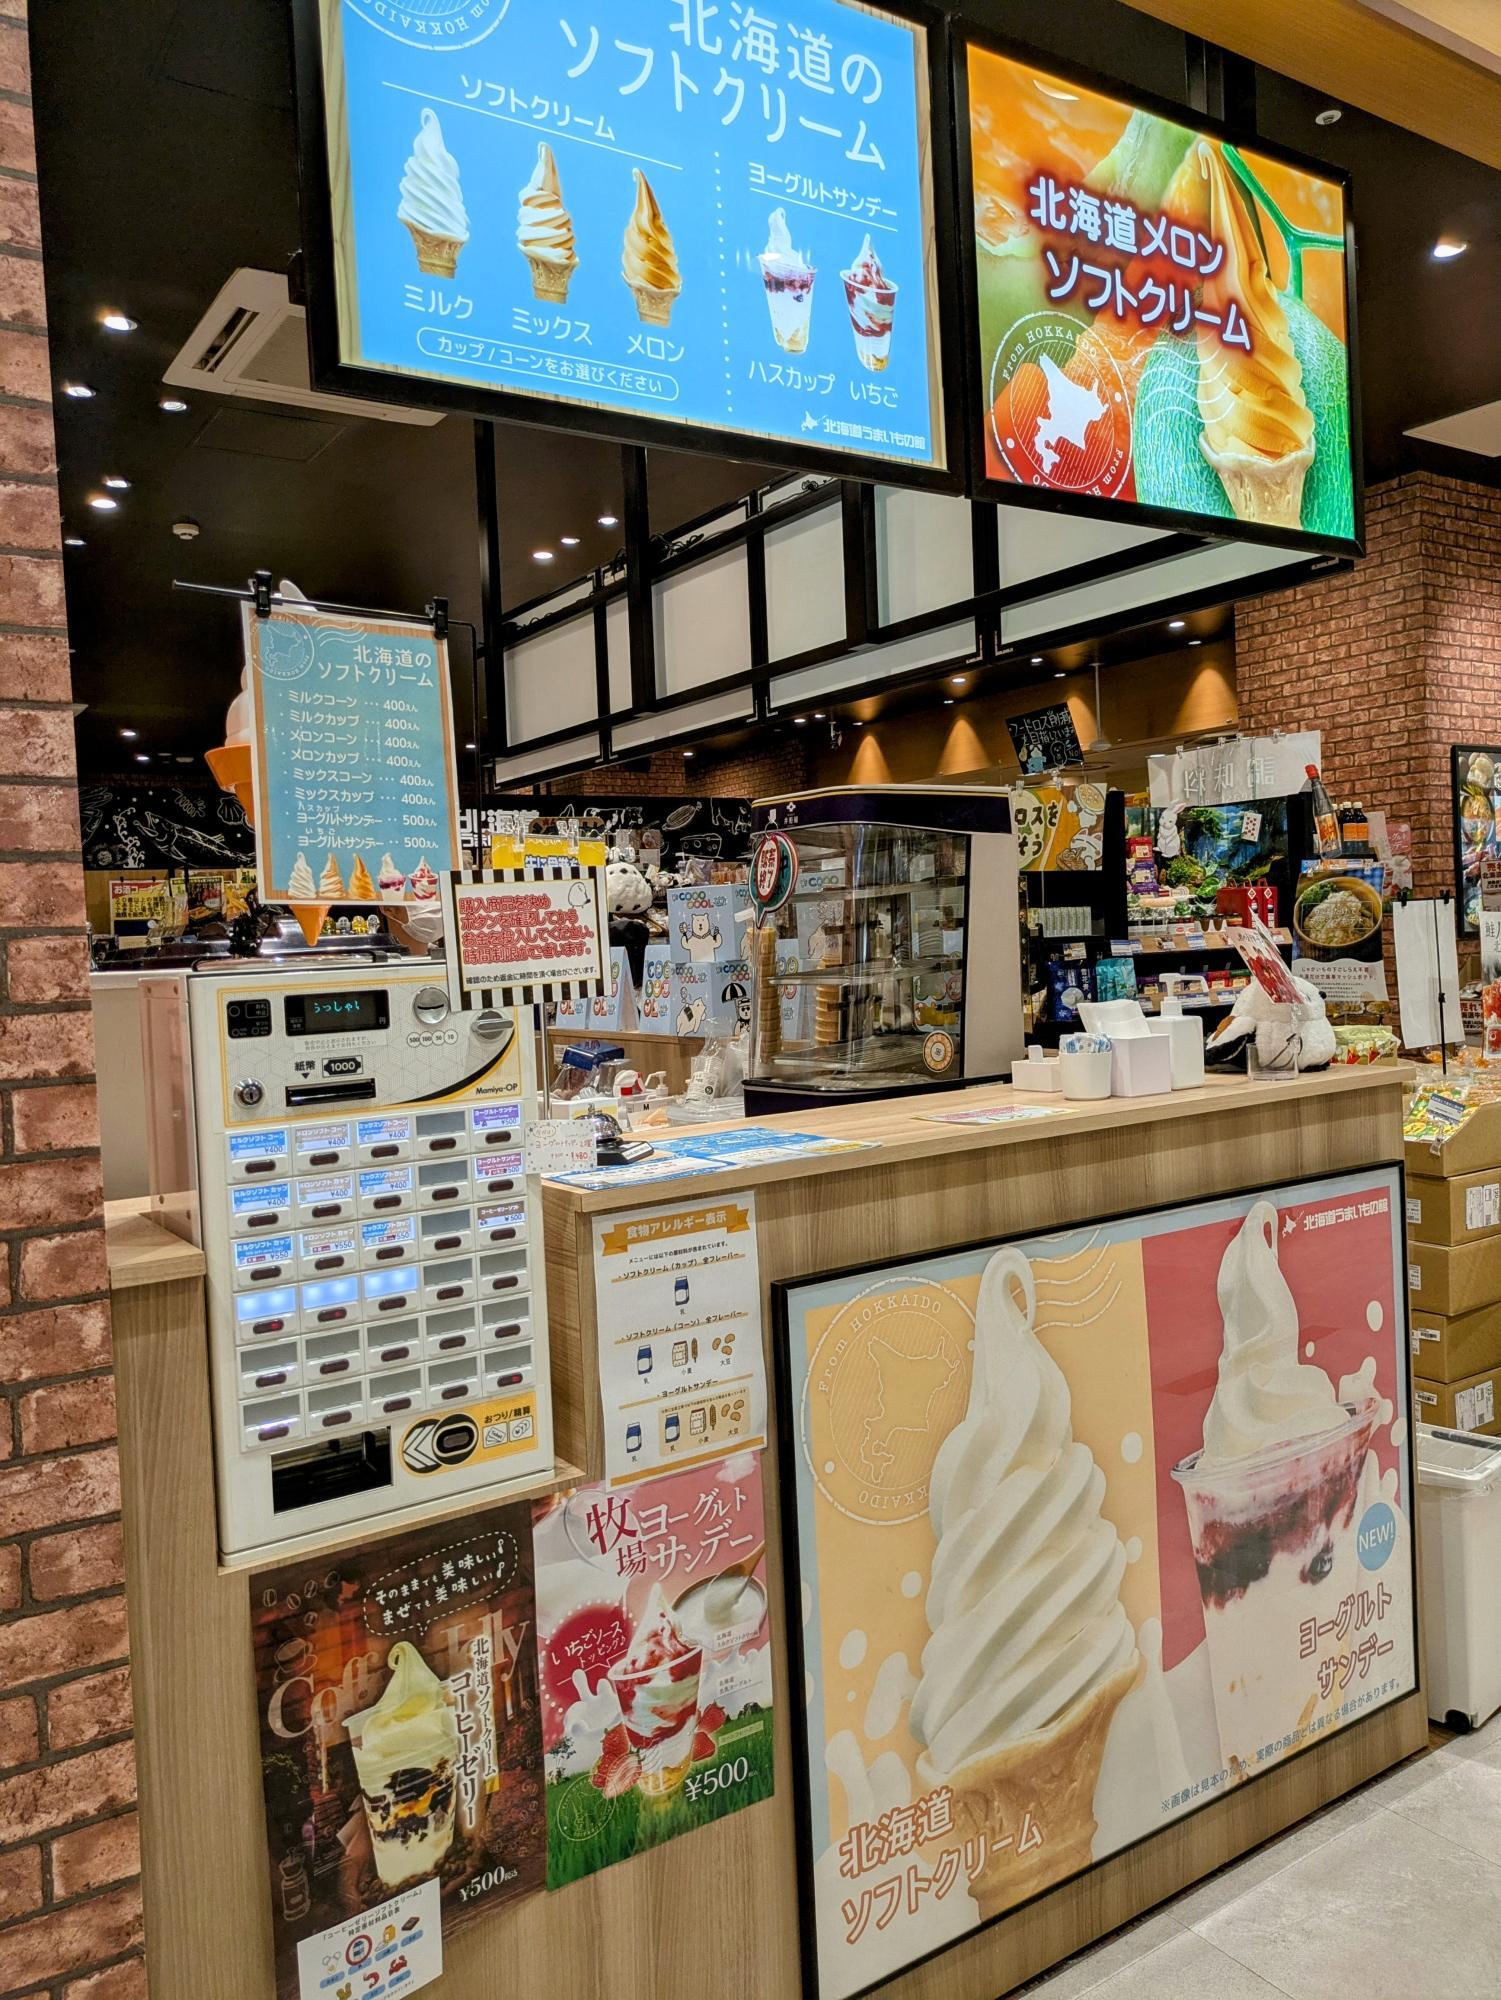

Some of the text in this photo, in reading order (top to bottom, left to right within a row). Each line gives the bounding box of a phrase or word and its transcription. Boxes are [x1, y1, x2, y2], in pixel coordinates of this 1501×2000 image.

[670, 0, 883, 104] 北海道の
[461, 73, 616, 142] ソフトクリーム
[559, 18, 887, 171] ソフトクリーム
[748, 162, 899, 219] ヨーグルトサンデー
[1029, 175, 1224, 275] 北海道メロン
[403, 284, 474, 321] ミルク
[1045, 250, 1252, 351] ソフトクリーム
[511, 306, 594, 346] ミックス
[627, 334, 686, 364] メロン
[747, 361, 836, 398] ハスカップ
[849, 380, 900, 409] いちご
[823, 418, 926, 450] 北海道うまいもの館
[353, 644, 433, 669] 北海道の
[318, 661, 434, 688] ソフトクリーム
[288, 689, 419, 713] ミルクコーン 400えん
[289, 708, 420, 731] ミルクカップ 400えん
[289, 729, 420, 750] メロンコーン 400えん
[290, 748, 422, 768] メロンカップ 400えん
[293, 767, 435, 788] ミックスコーン 400えん
[294, 786, 437, 806] ミックスカップ 400えん
[296, 811, 437, 828] ヨーグルトサンデー 500えん
[1014, 801, 1059, 827] ロスを
[298, 835, 439, 850] ヨーグルトサンデー 500えん
[458, 893, 551, 915] 購入商品を決め
[460, 909, 579, 931] ボタンを確認してから
[463, 941, 592, 966] 時間制限がございます。
[294, 1060, 356, 1071] 紙幣 1000
[475, 1083, 518, 1095] Mamiya-OP
[625, 1210, 728, 1240] 食物アレルギー表示
[1303, 1197, 1389, 1231] 北海道うまいもの館
[702, 1252, 740, 1265] 全フレーバー
[705, 1311, 742, 1323] 全フレーバー
[849, 1294, 942, 1334] HOKKAIDO
[719, 1358, 731, 1367] 大豆
[661, 1378, 719, 1398] ヨーグルトサンデー
[637, 1487, 747, 1542] ヨーグルト
[585, 1496, 648, 1578] 牧場
[649, 1518, 754, 1582] サンデー
[1358, 1521, 1395, 1553] NEW!
[1299, 1581, 1393, 1660] ヨーグルト
[551, 1620, 623, 1666] いちごソース
[1317, 1632, 1394, 1700] サンデー
[472, 1636, 498, 1778] 北海道ソフトクリーム
[450, 1670, 481, 1828] コーヒーゼリー
[684, 1756, 749, 1802] ¥500
[839, 1785, 954, 1880] 北海道
[459, 1866, 506, 1903] ¥500
[841, 1809, 1044, 1945] ソフトクリーム
